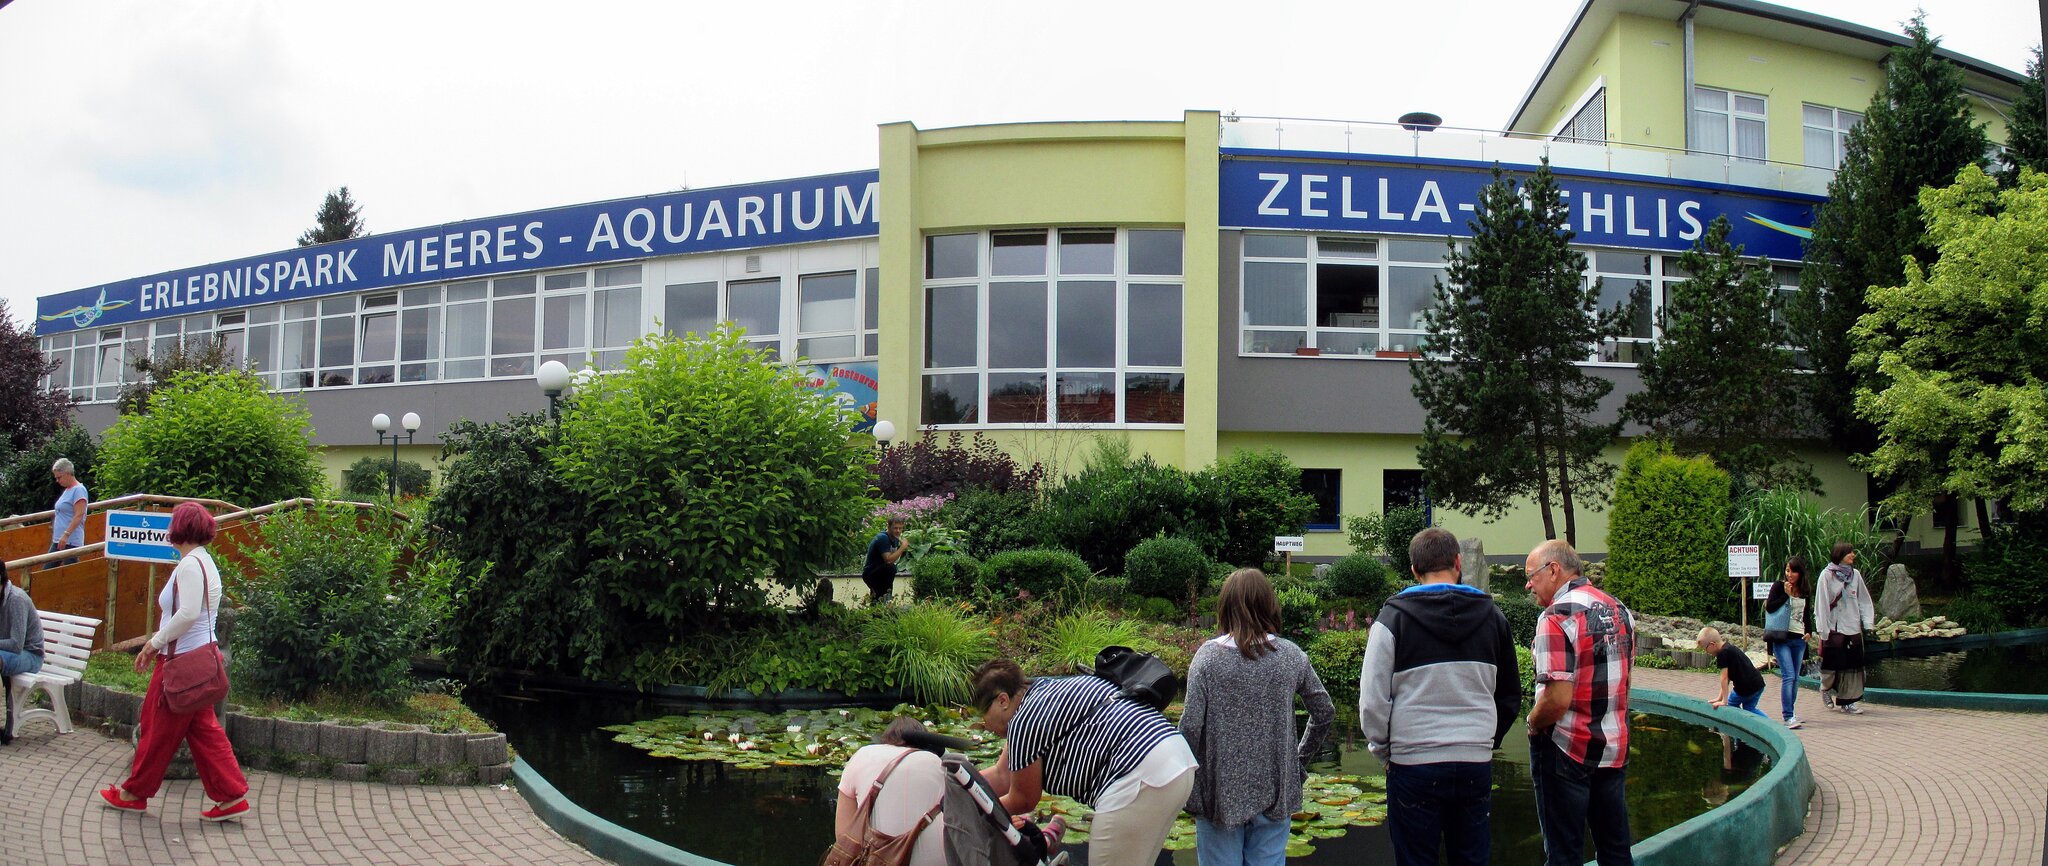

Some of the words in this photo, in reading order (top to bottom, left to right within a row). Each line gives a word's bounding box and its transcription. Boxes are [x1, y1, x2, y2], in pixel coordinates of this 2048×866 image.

[140, 249, 358, 312] ERLEBNISPARK
[383, 221, 544, 277] MEERES
[586, 181, 879, 253] AQUARIUM
